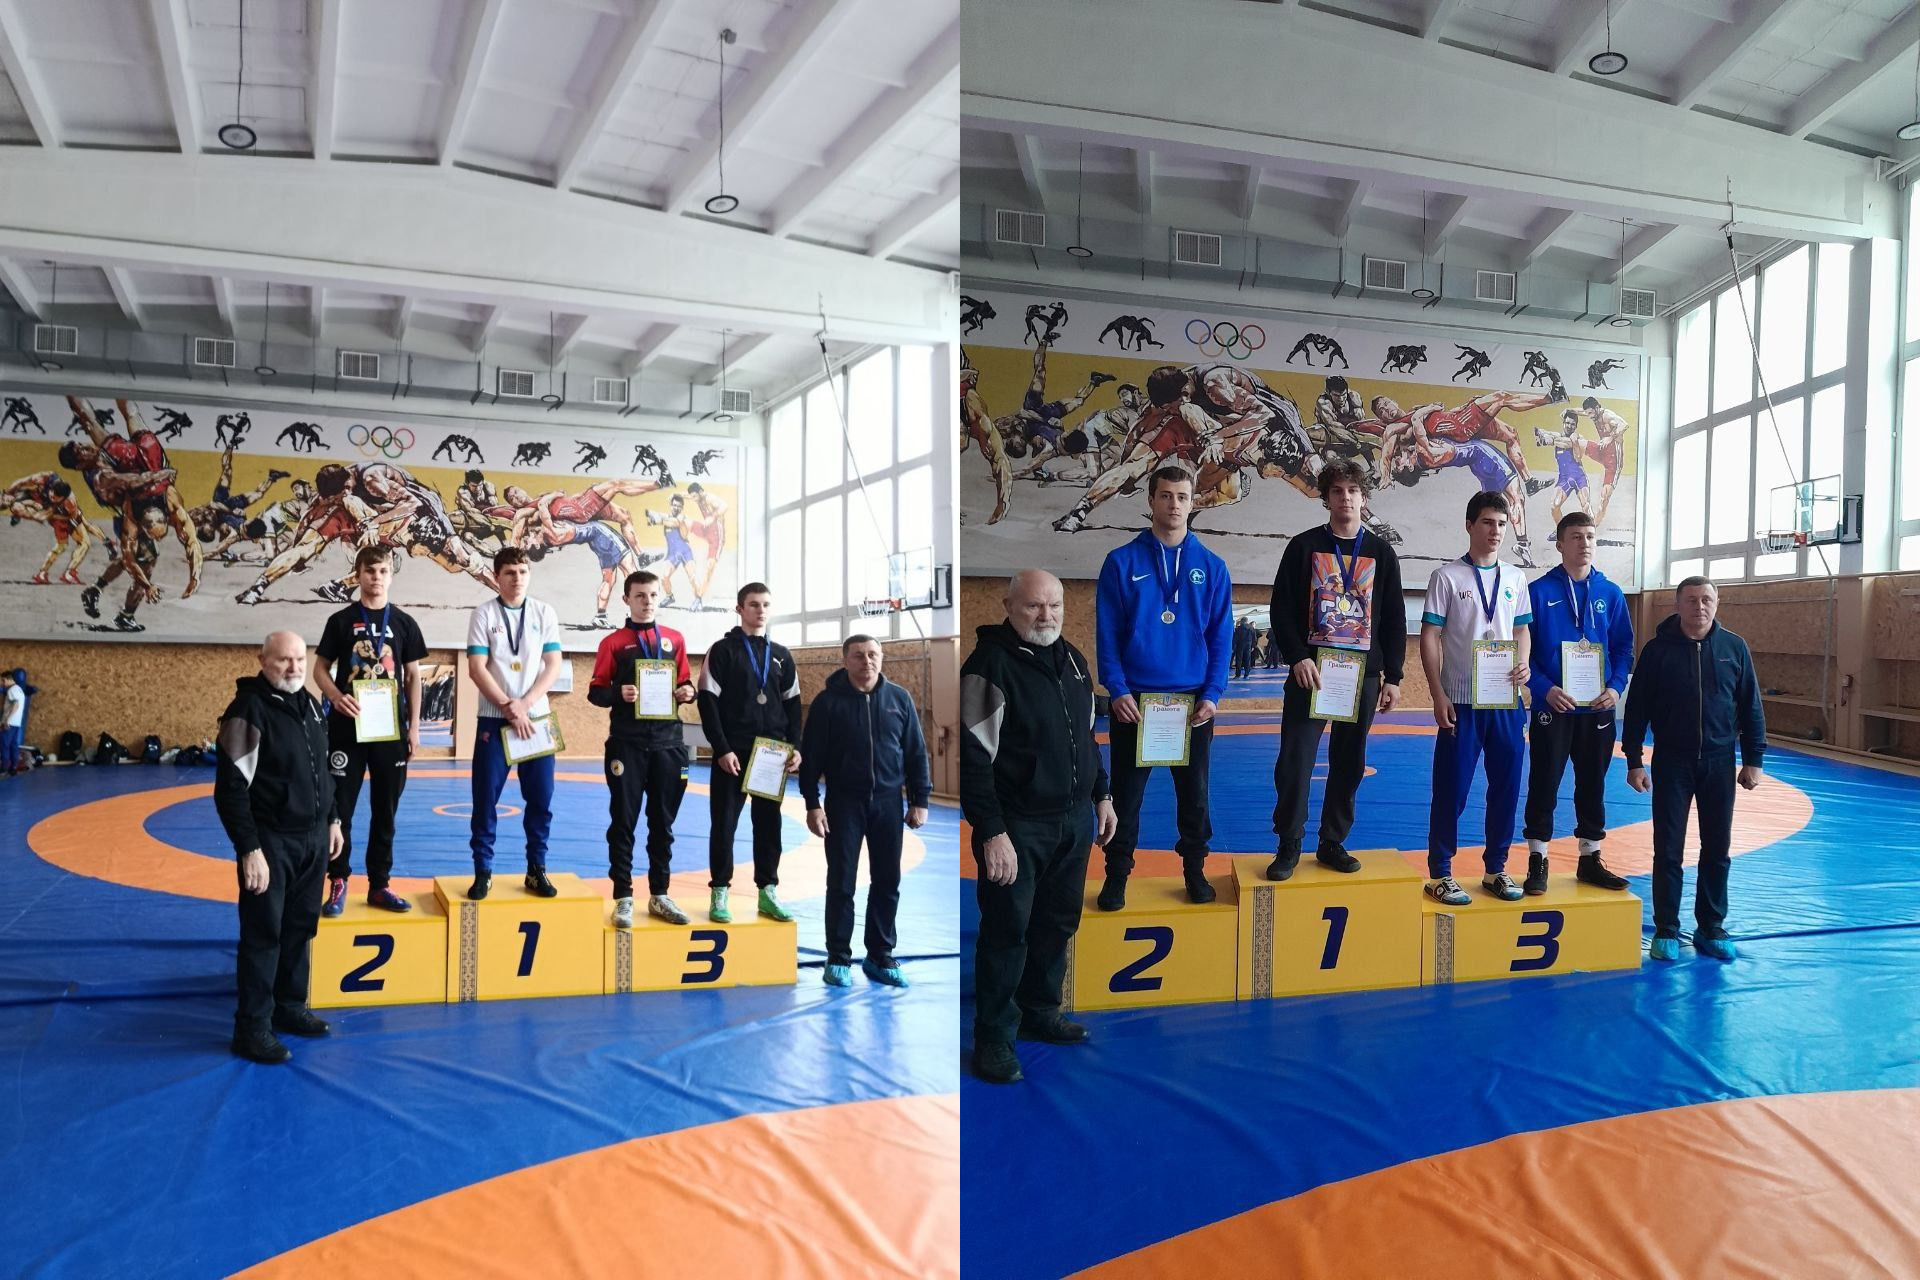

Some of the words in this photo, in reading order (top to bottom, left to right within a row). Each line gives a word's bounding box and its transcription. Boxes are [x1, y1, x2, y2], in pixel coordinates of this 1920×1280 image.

[352, 622, 394, 639] FLA
[1152, 705, 1181, 713] Грамота
[340, 934, 394, 993] 2
[518, 921, 542, 977] 1
[682, 929, 728, 983] 3
[1109, 926, 1174, 993] 2
[1320, 906, 1349, 970] 1
[1510, 910, 1565, 972] 3
